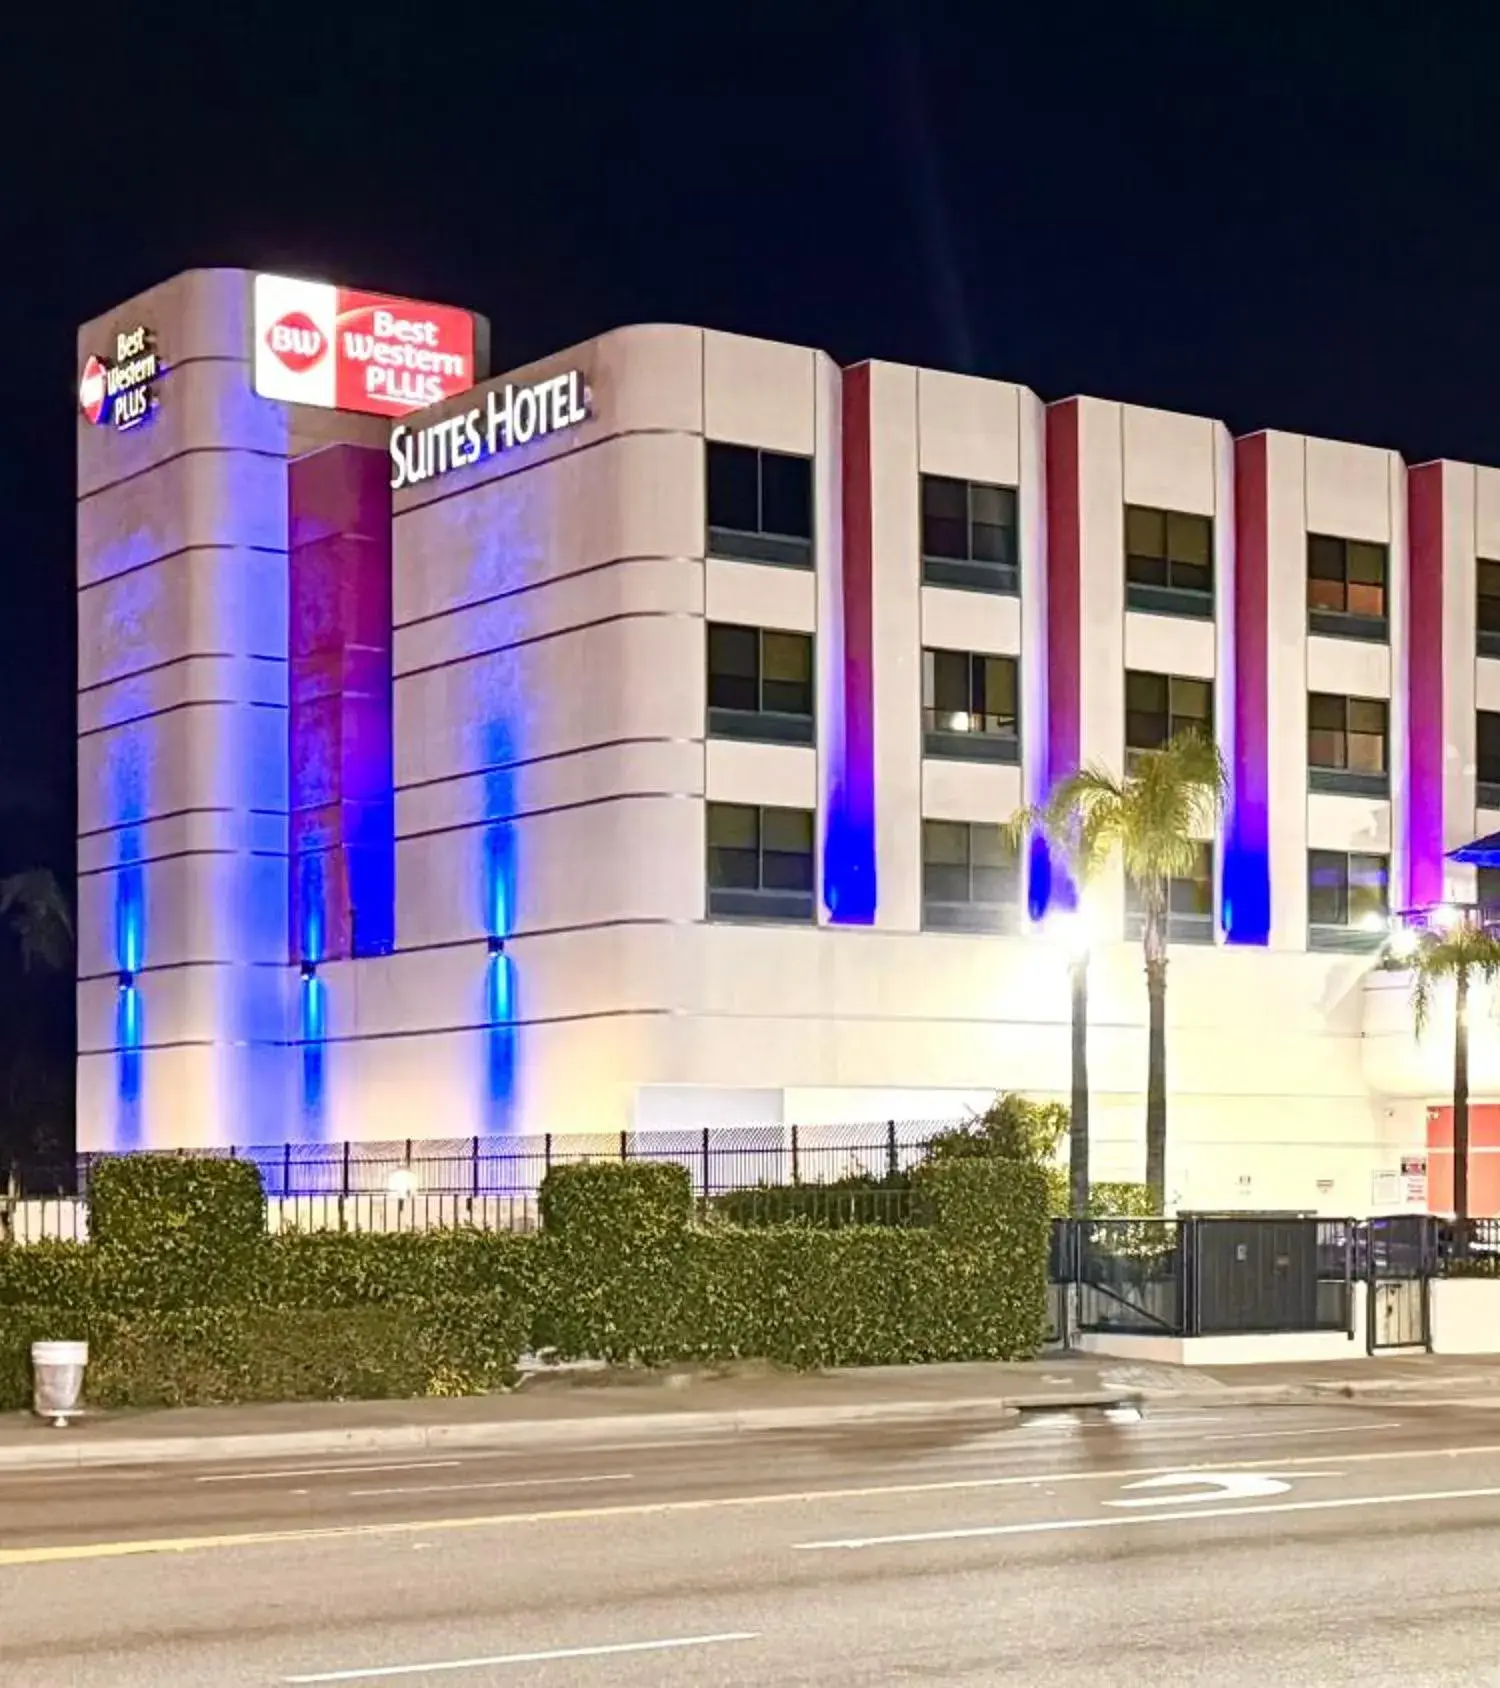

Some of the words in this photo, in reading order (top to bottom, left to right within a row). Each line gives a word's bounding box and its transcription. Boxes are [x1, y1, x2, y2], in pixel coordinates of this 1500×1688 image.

[117, 326, 145, 361] Best
[271, 324, 321, 357] BW
[373, 310, 438, 346] Best
[343, 331, 465, 376] Western
[107, 354, 156, 396] Western
[366, 364, 445, 402] PLUS
[115, 385, 147, 425] PLUS
[389, 407, 480, 489] SUITES
[486, 370, 586, 455] HOTEL
